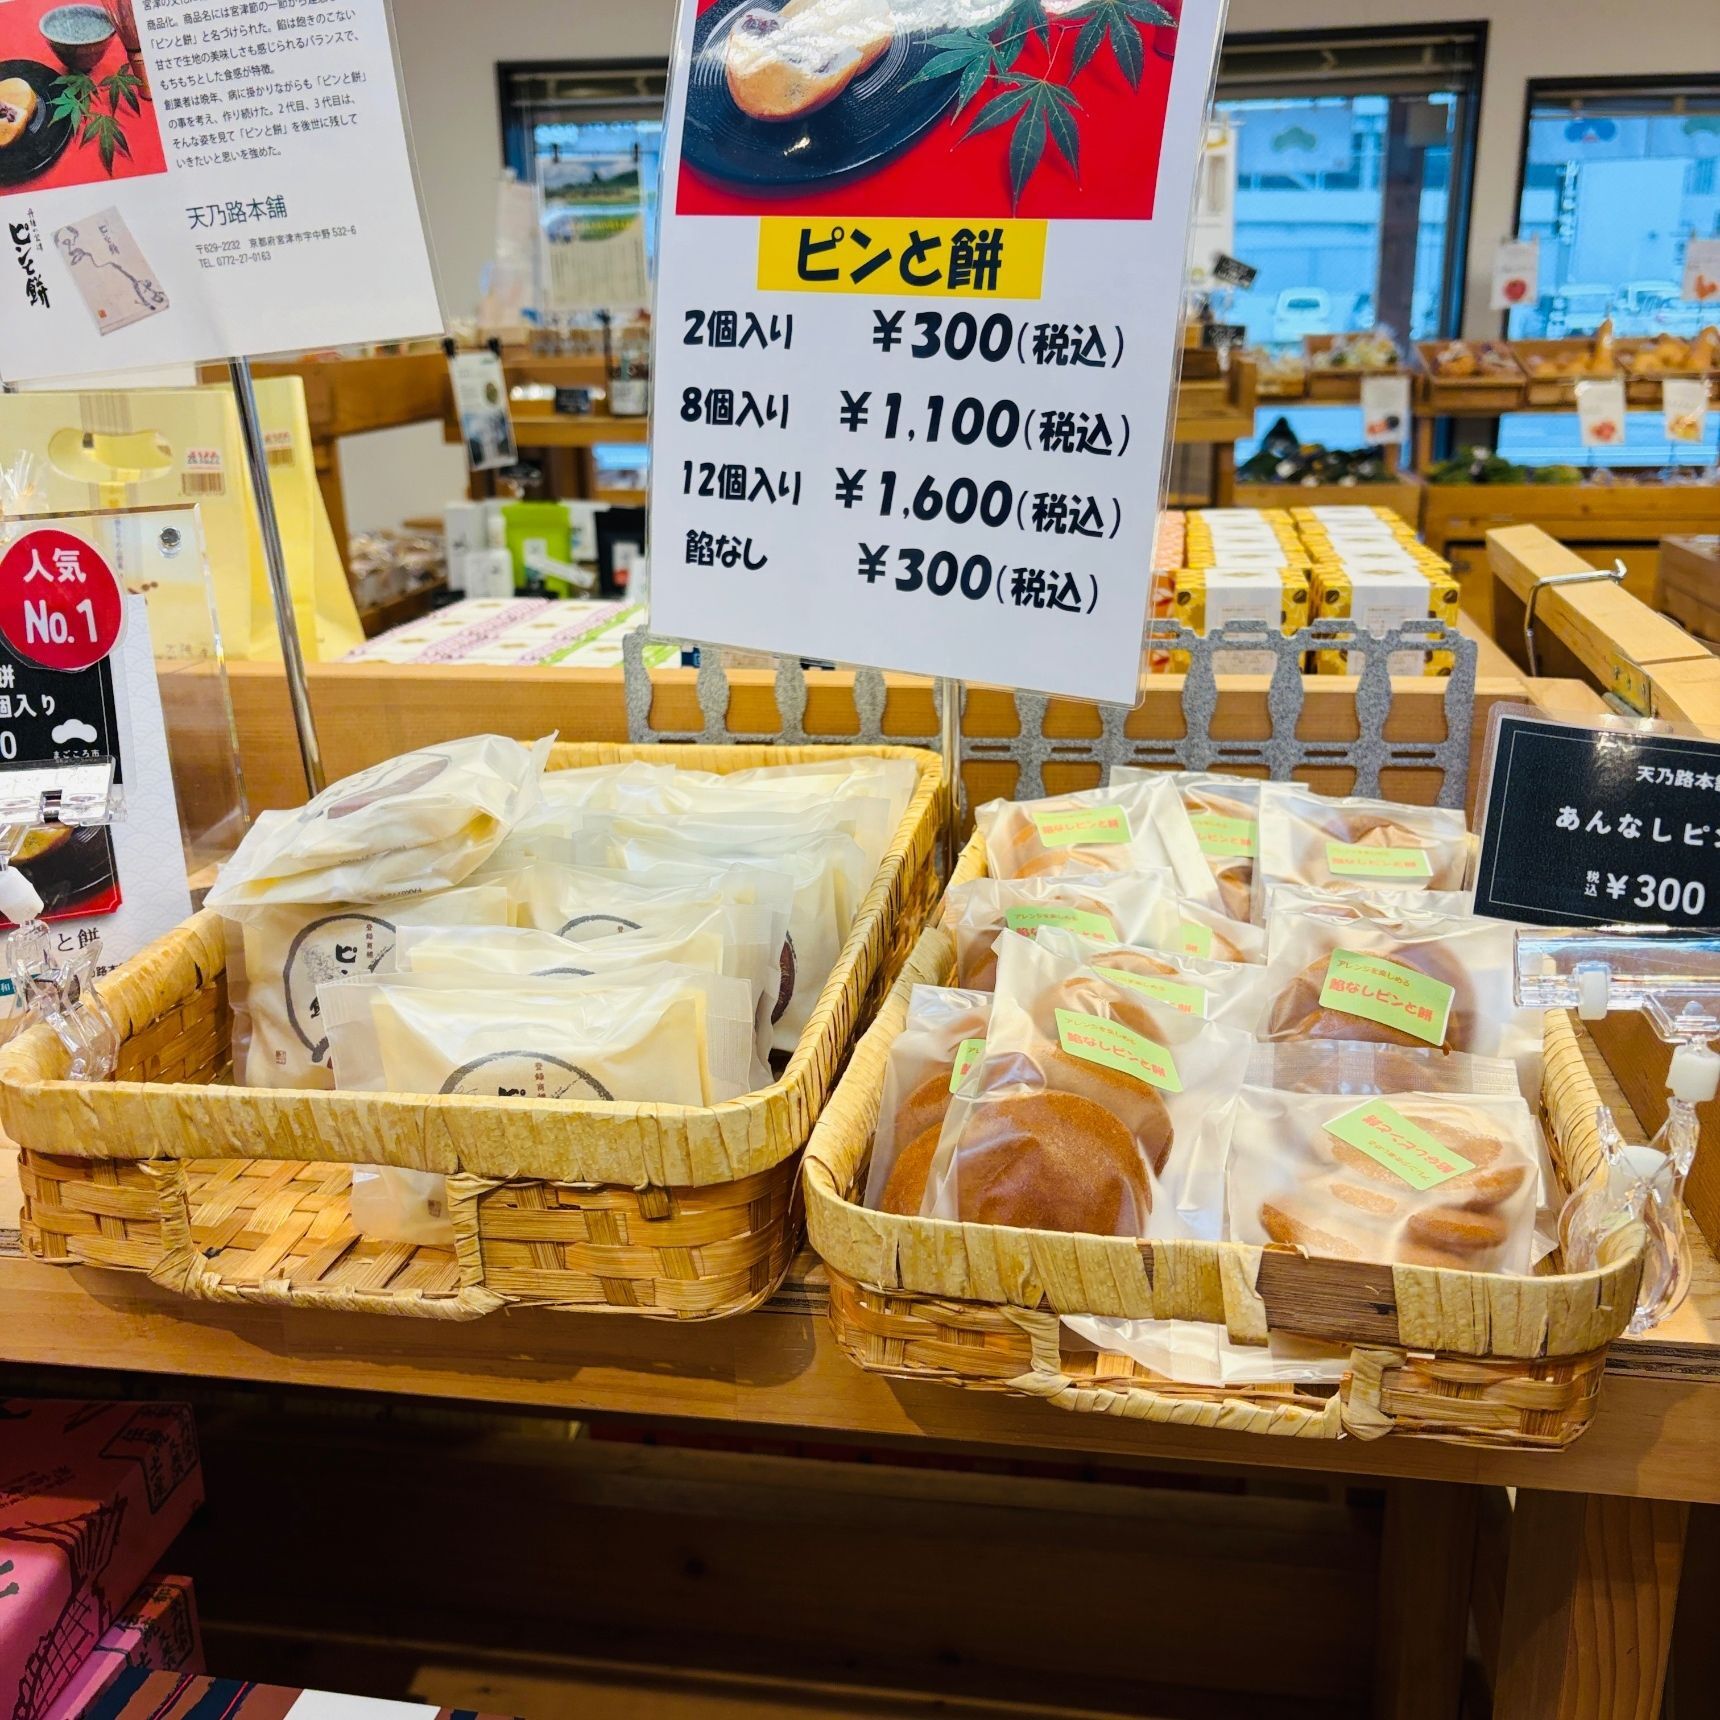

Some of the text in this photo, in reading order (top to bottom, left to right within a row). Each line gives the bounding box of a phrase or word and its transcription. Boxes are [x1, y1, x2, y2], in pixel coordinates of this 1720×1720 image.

[176, 146, 282, 168] いきたいと思いを強めた。
[185, 194, 288, 230] 天乃路本舗
[796, 226, 1004, 291] ピンと餅
[683, 310, 793, 350] 2個入り
[680, 387, 789, 429] 8個入り
[683, 460, 801, 505] 12個入り
[23, 548, 87, 583] 人気
[685, 529, 768, 571] 餡なし
[24, 598, 98, 644] No.1
[53, 749, 100, 759] まごころ市
[1606, 873, 1706, 916] ¥300
[1329, 977, 1434, 1022] 餡なしピンと餅
